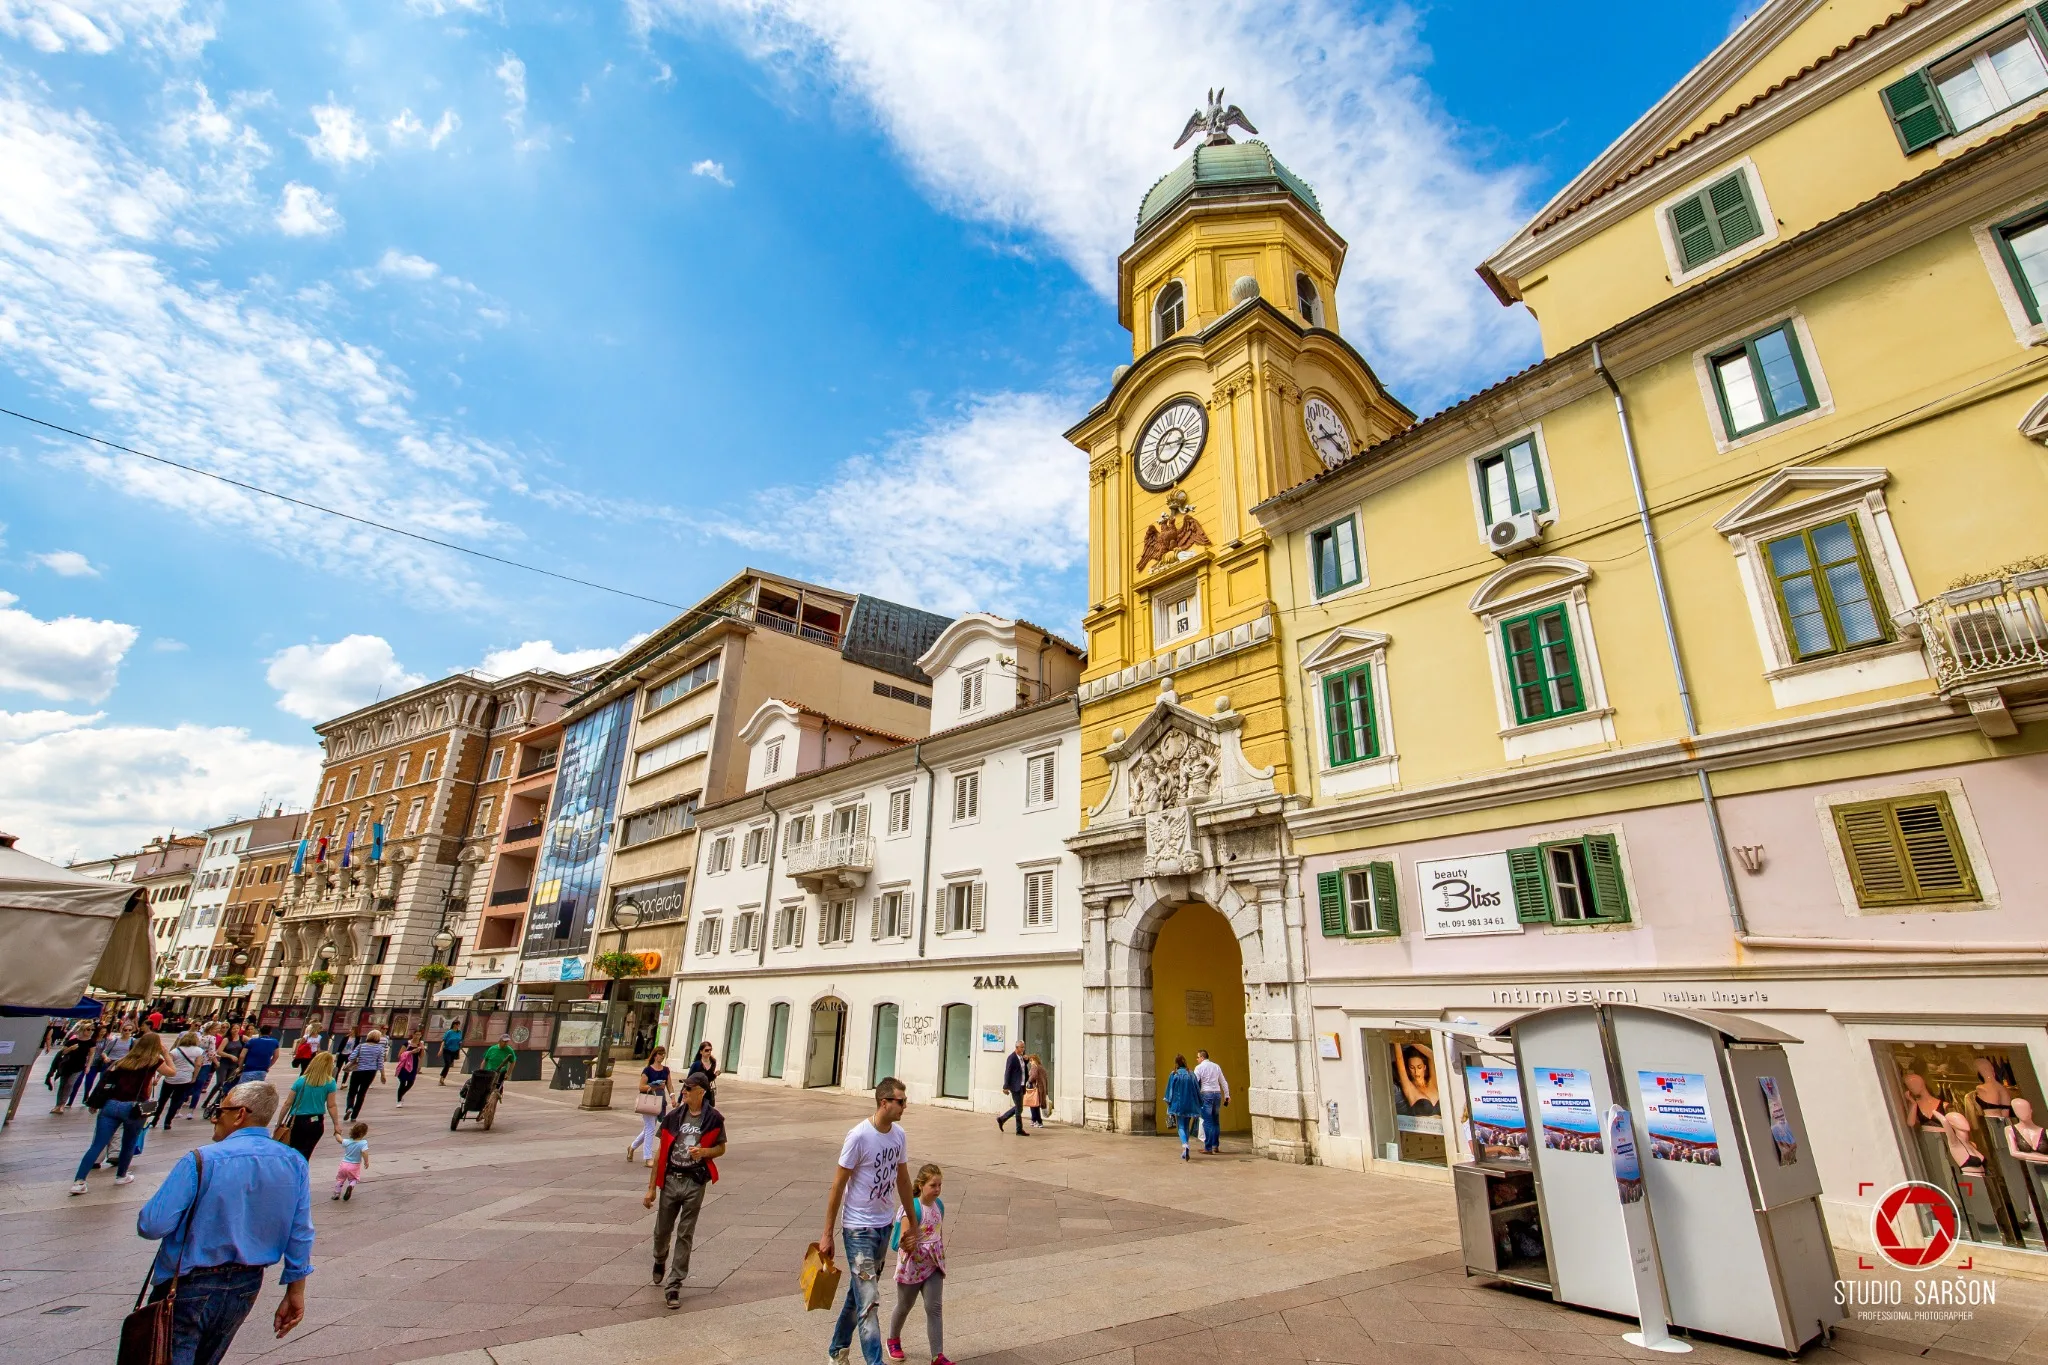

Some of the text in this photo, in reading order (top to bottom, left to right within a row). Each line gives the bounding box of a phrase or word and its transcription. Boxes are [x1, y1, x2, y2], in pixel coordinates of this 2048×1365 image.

[1434, 869, 1468, 880] beauty
[1432, 879, 1501, 912] Bliss
[1438, 920, 1450, 928] tel.
[1452, 920, 1466, 928] 091
[1467, 918, 1481, 927] 981
[1495, 917, 1504, 925] 61
[972, 975, 1019, 990] ZARA
[708, 985, 730, 995] ZARA
[1659, 1106, 1704, 1114] REFERENDUM
[874, 1145, 901, 1168] SHOW
[873, 1161, 898, 1184] SOM
